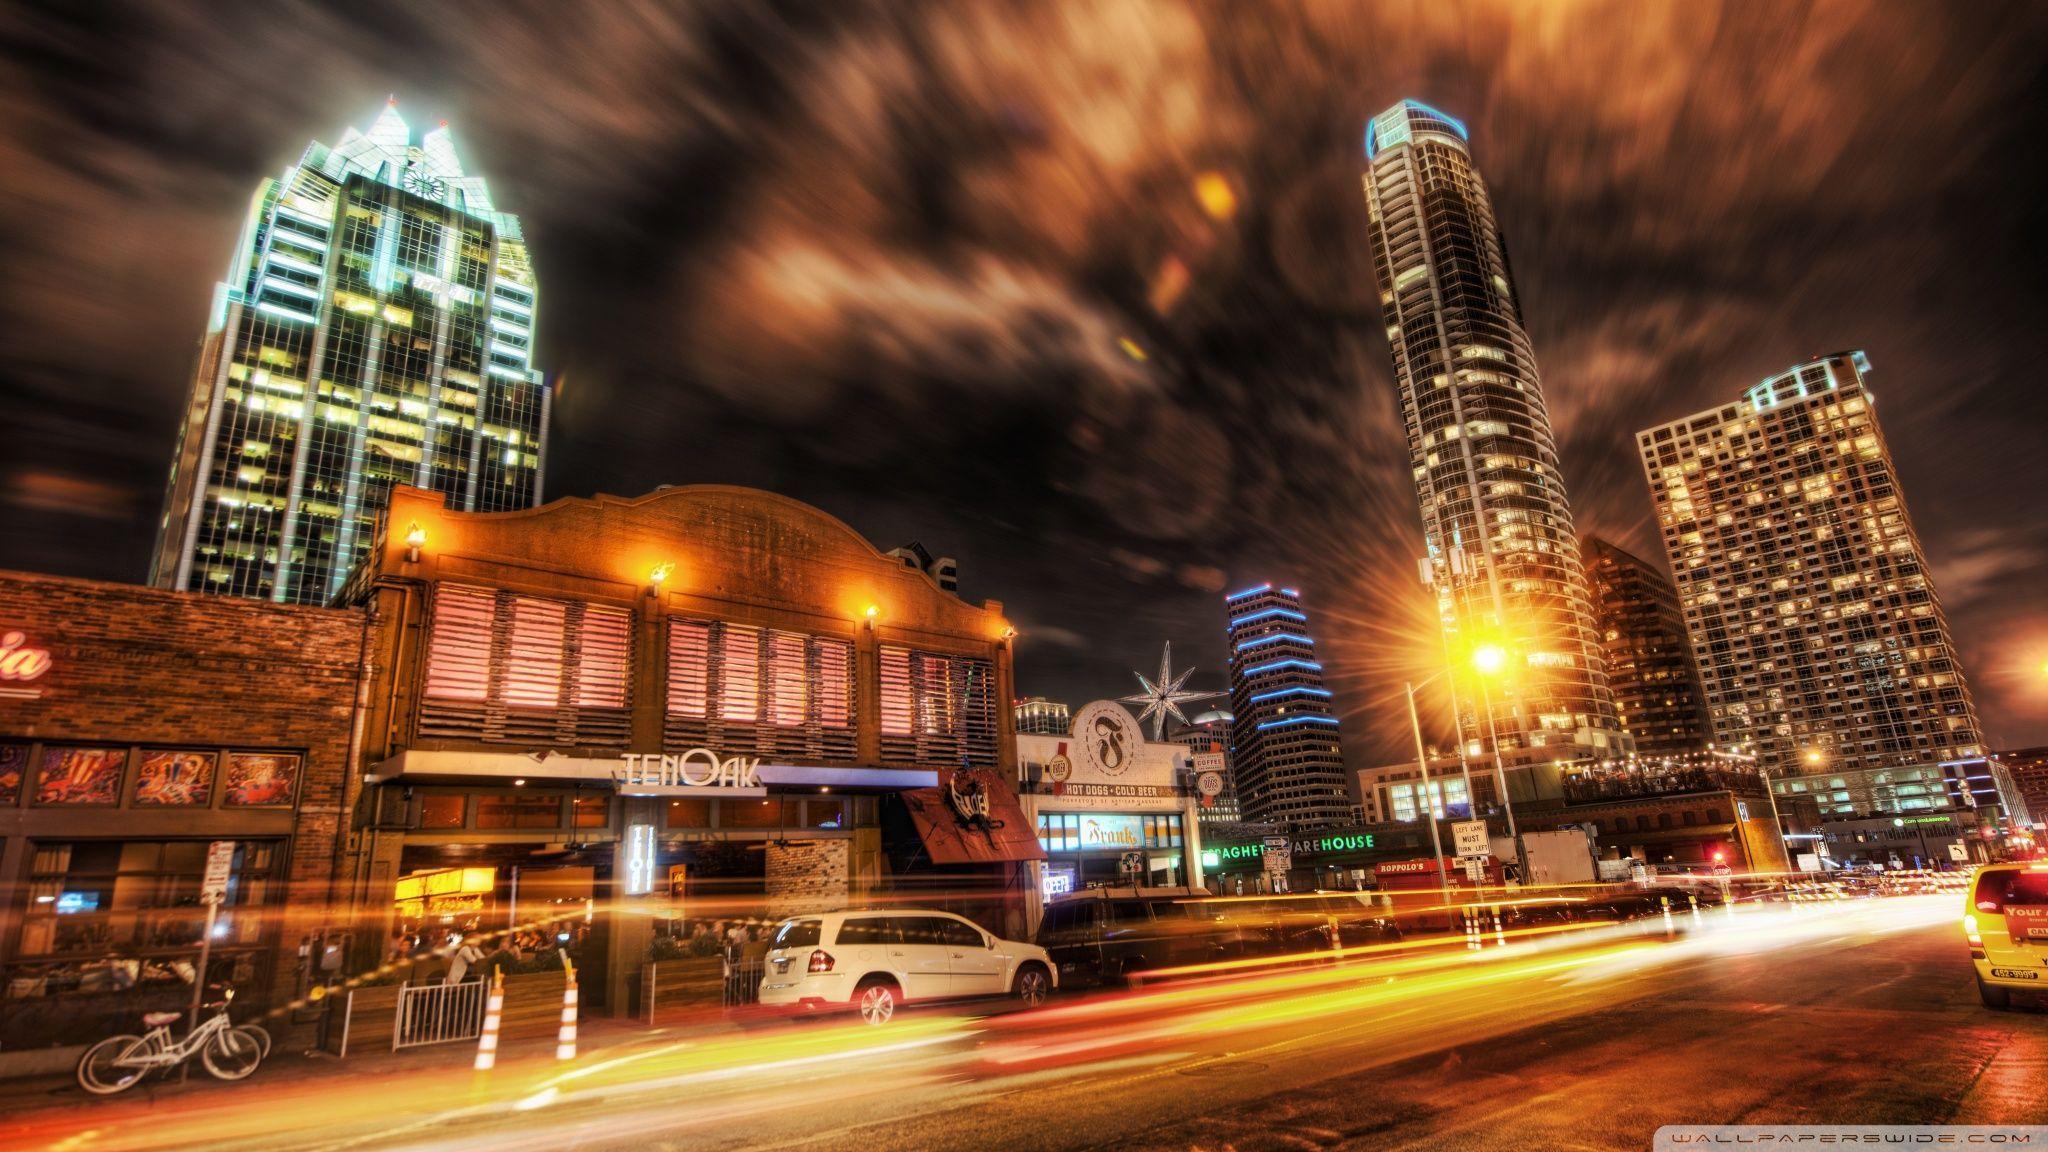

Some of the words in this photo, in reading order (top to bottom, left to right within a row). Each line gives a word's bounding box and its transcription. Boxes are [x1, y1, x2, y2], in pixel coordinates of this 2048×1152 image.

[1066, 784, 1084, 795] HOT
[1086, 785, 1109, 795] DOGS
[1115, 786, 1136, 796] COLD
[1138, 786, 1158, 797] BEER
[1087, 819, 1137, 846] Frank
[1456, 825, 1468, 833] LEFT
[1462, 834, 1479, 843] MUST
[1207, 844, 1272, 860] PAGHET
[1380, 863, 1424, 873] ROPPOLO'S
[2006, 906, 2042, 917] Your
